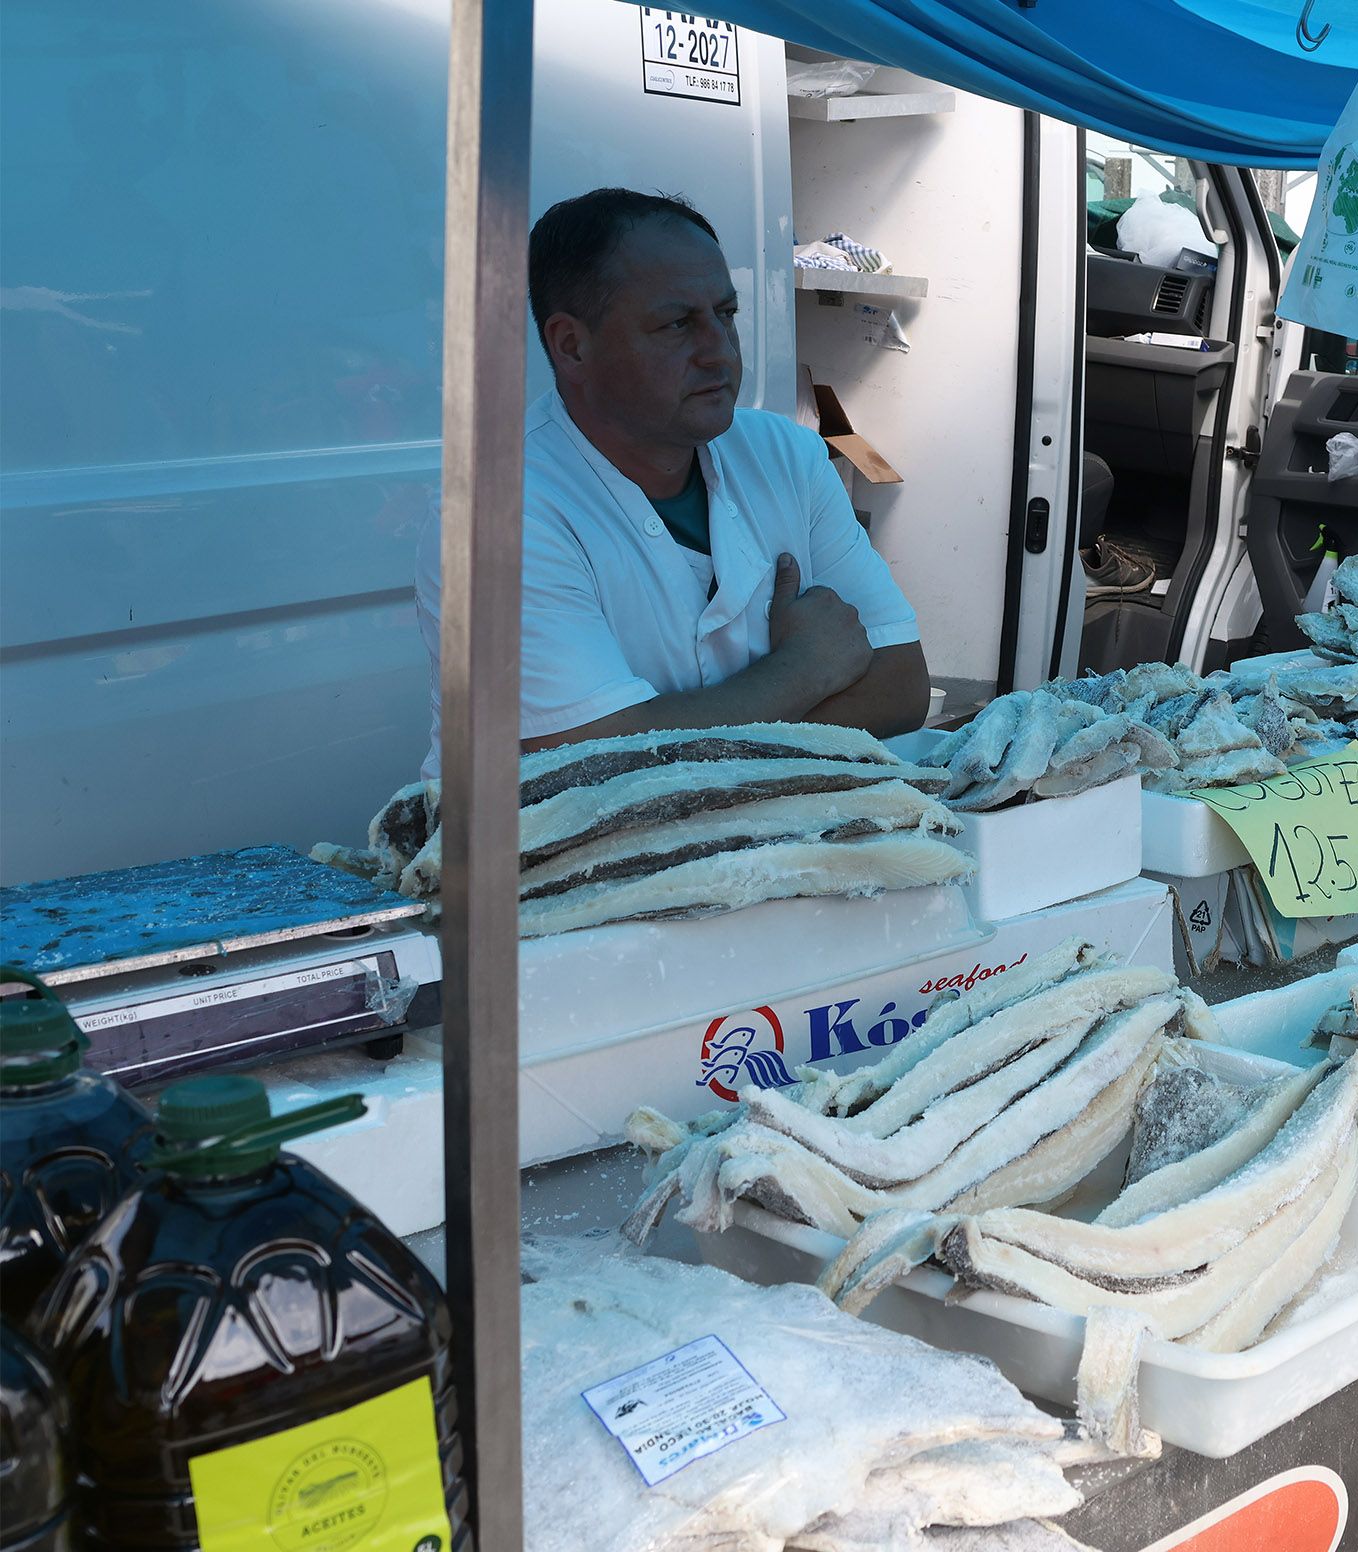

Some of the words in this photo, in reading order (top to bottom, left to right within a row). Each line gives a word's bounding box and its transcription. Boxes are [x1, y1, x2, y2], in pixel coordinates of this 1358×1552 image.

[655, 23, 729, 68] 12-2027
[1191, 924, 1206, 933] PAP
[297, 972, 320, 984] TOTAL
[321, 967, 344, 979] PRICE
[193, 994, 212, 1007] UNIT
[214, 990, 238, 1003] PRICE
[82, 1011, 138, 1030] WEIGHT(kg)
[302, 1503, 366, 1537] ACEITES
